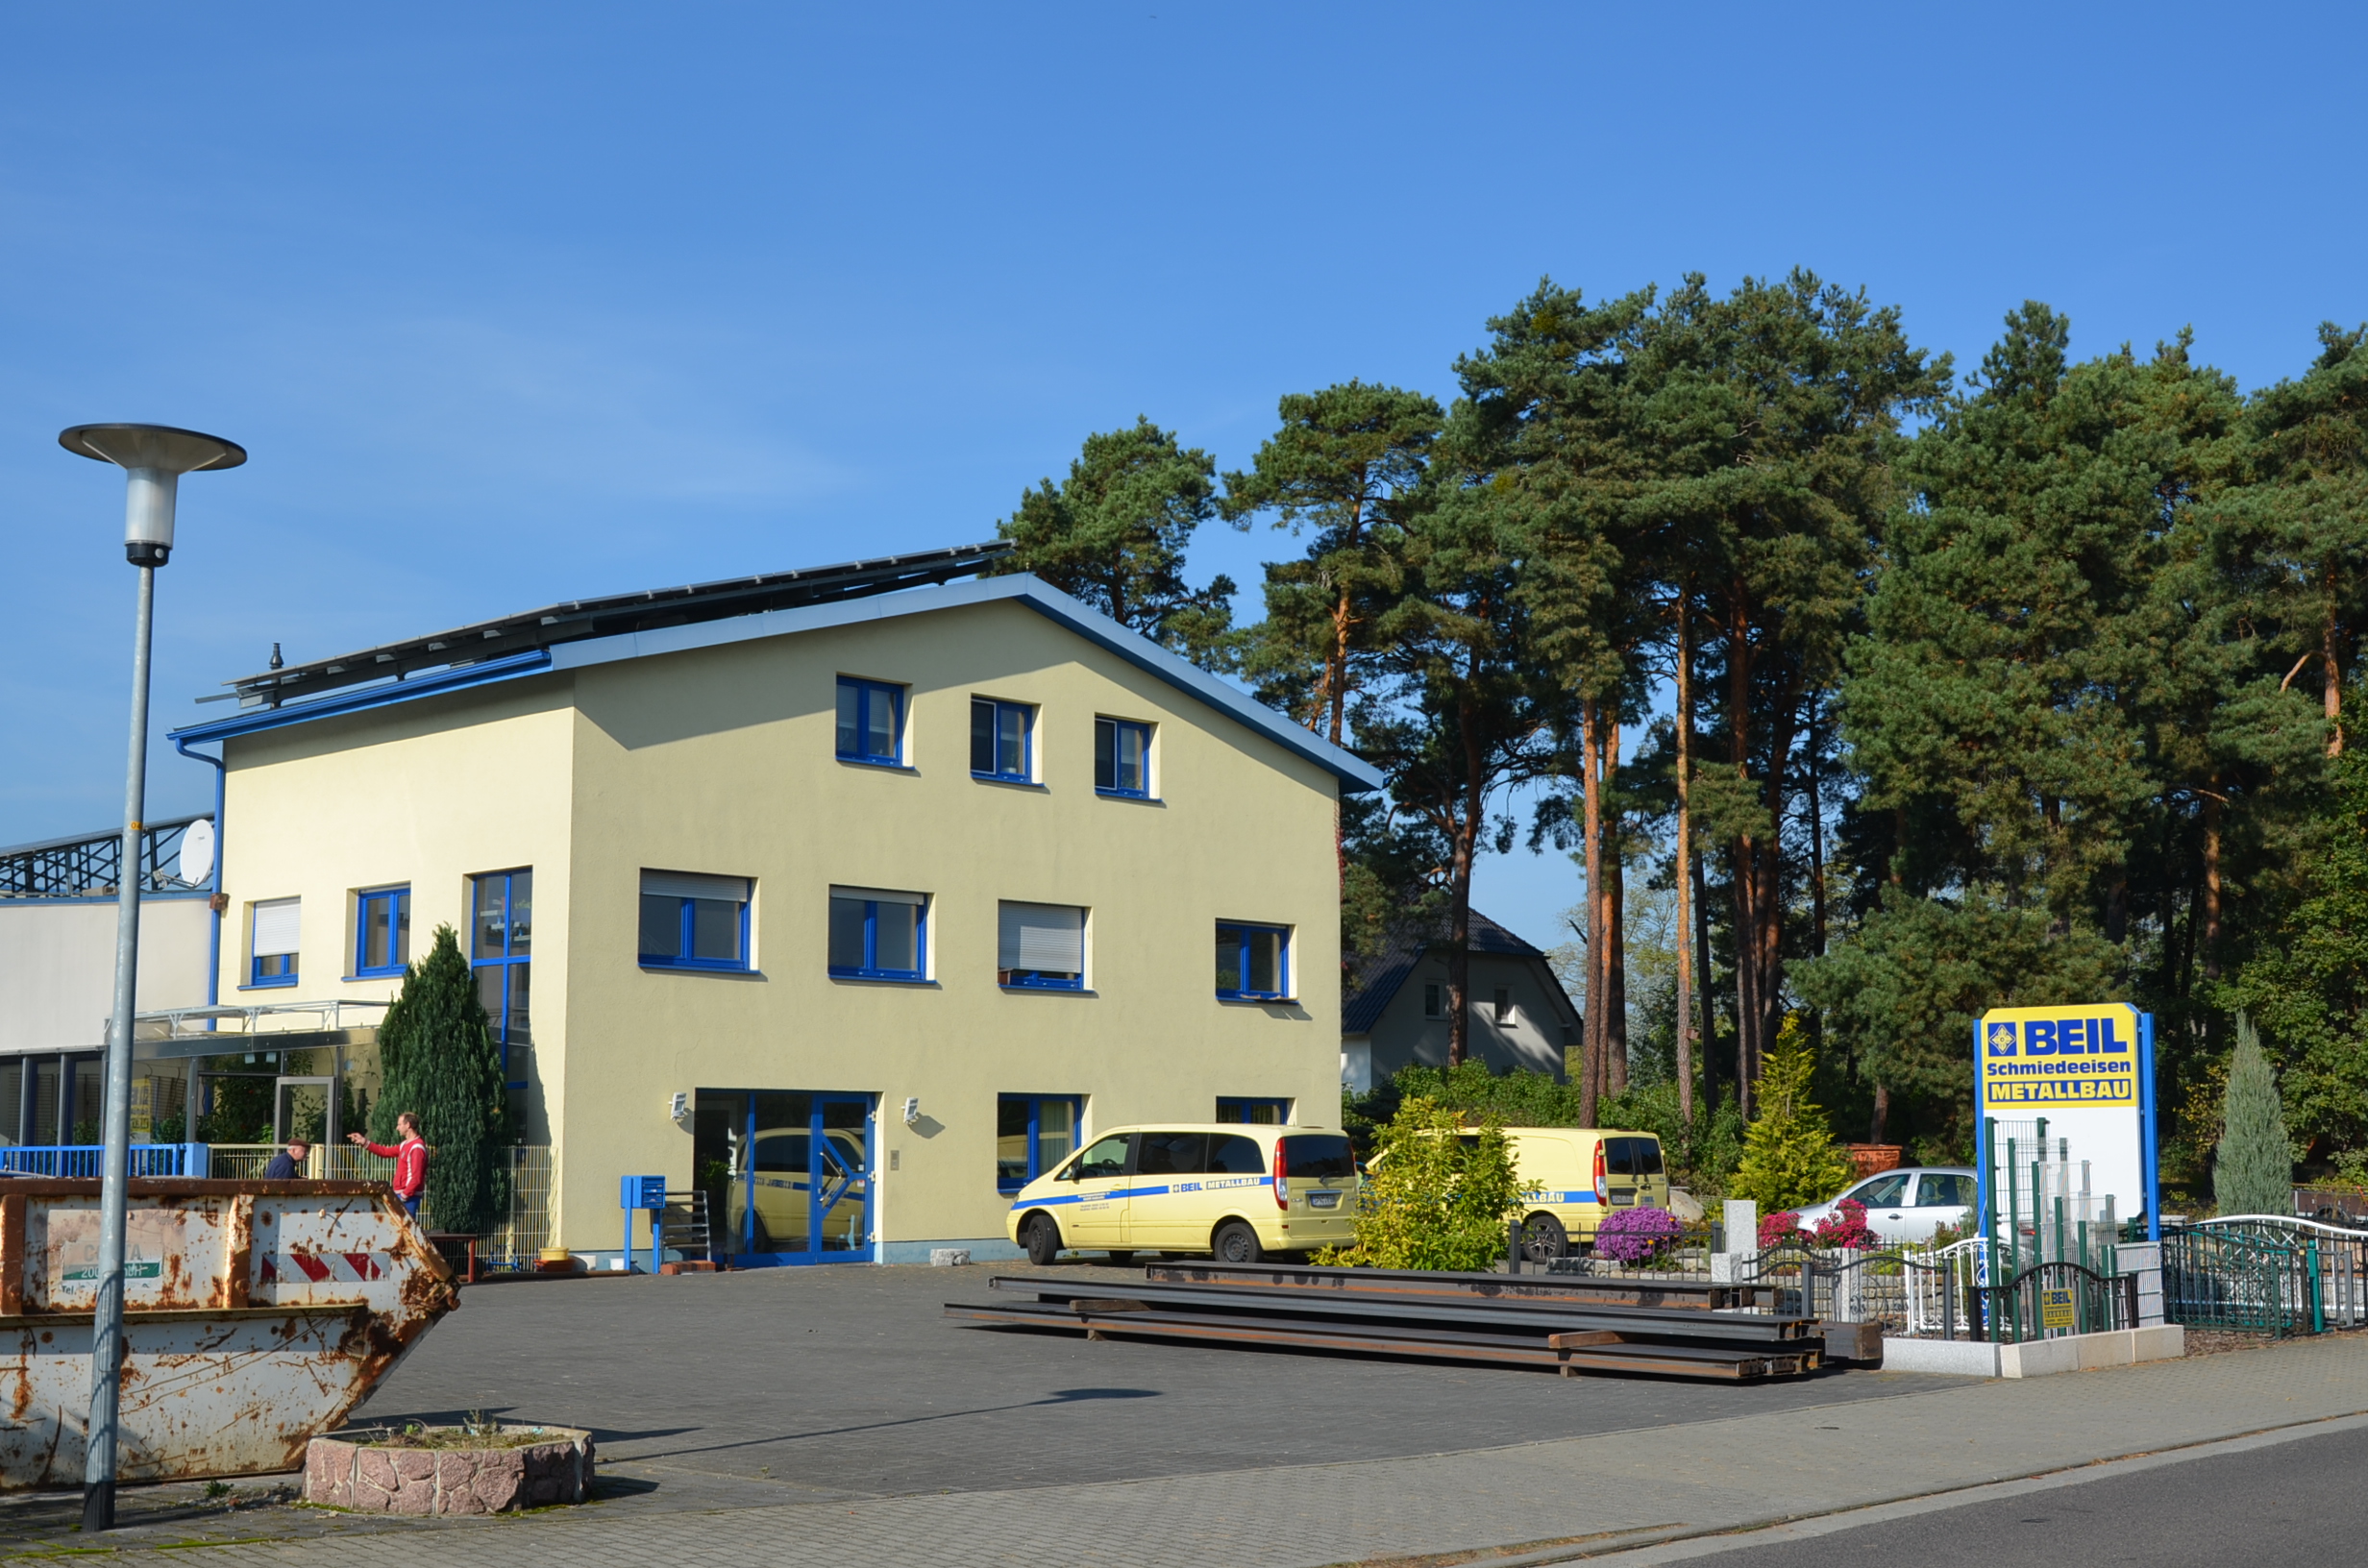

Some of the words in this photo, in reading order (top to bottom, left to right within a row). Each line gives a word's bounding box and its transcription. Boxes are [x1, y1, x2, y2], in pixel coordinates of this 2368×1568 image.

[2024, 1017, 2128, 1056] BEIL
[1986, 1060, 2132, 1076] Schmiedeeisen
[1991, 1081, 2130, 1101] METALLBAU
[1181, 1182, 1202, 1192] BEIL
[1207, 1177, 1260, 1189] METALLBAU
[2052, 1290, 2071, 1305] BEIL
